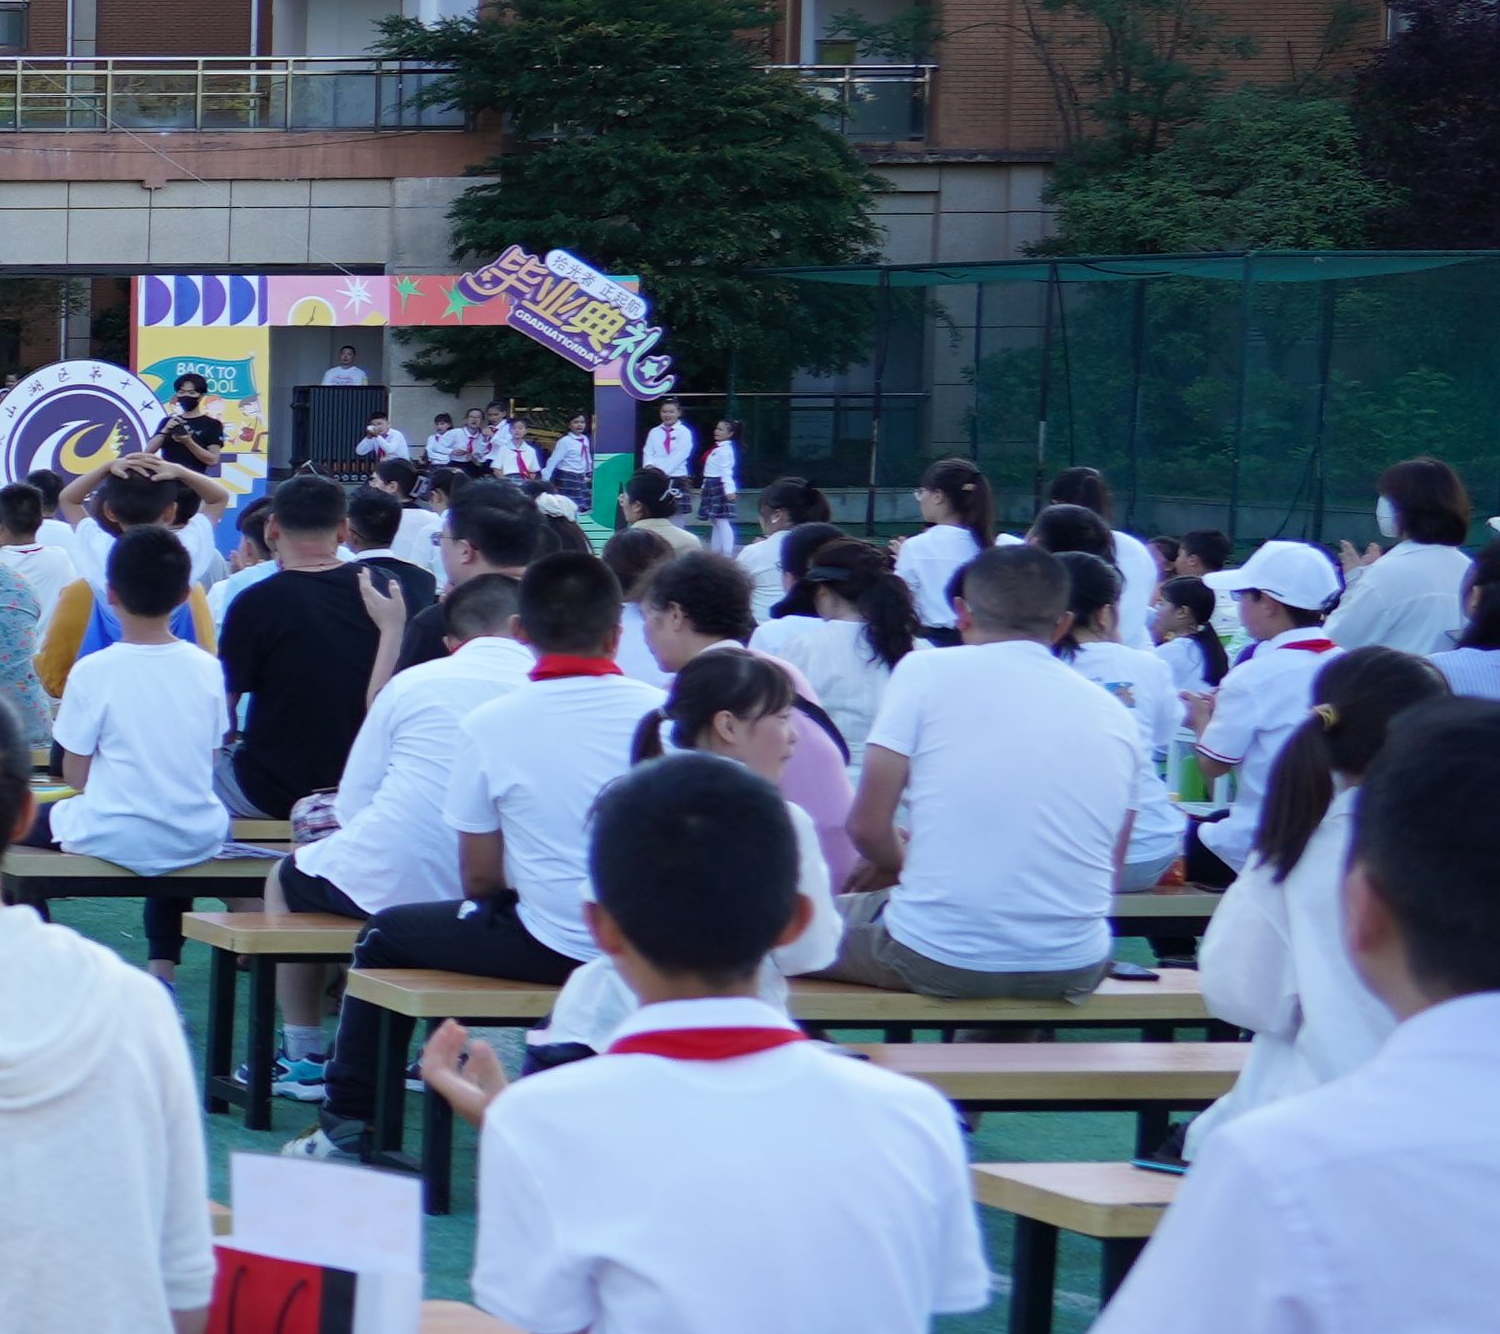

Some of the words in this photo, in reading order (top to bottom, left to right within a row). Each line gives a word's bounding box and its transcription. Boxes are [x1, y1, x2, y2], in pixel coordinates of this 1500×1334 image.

[554, 254, 597, 285] 拾光者
[599, 283, 642, 316] 正起航
[466, 248, 674, 395] 毕业典礼
[515, 309, 603, 365] GRADUATIONDAY
[177, 363, 215, 378] BACK
[216, 366, 236, 380] TO
[206, 378, 239, 393] OOL
